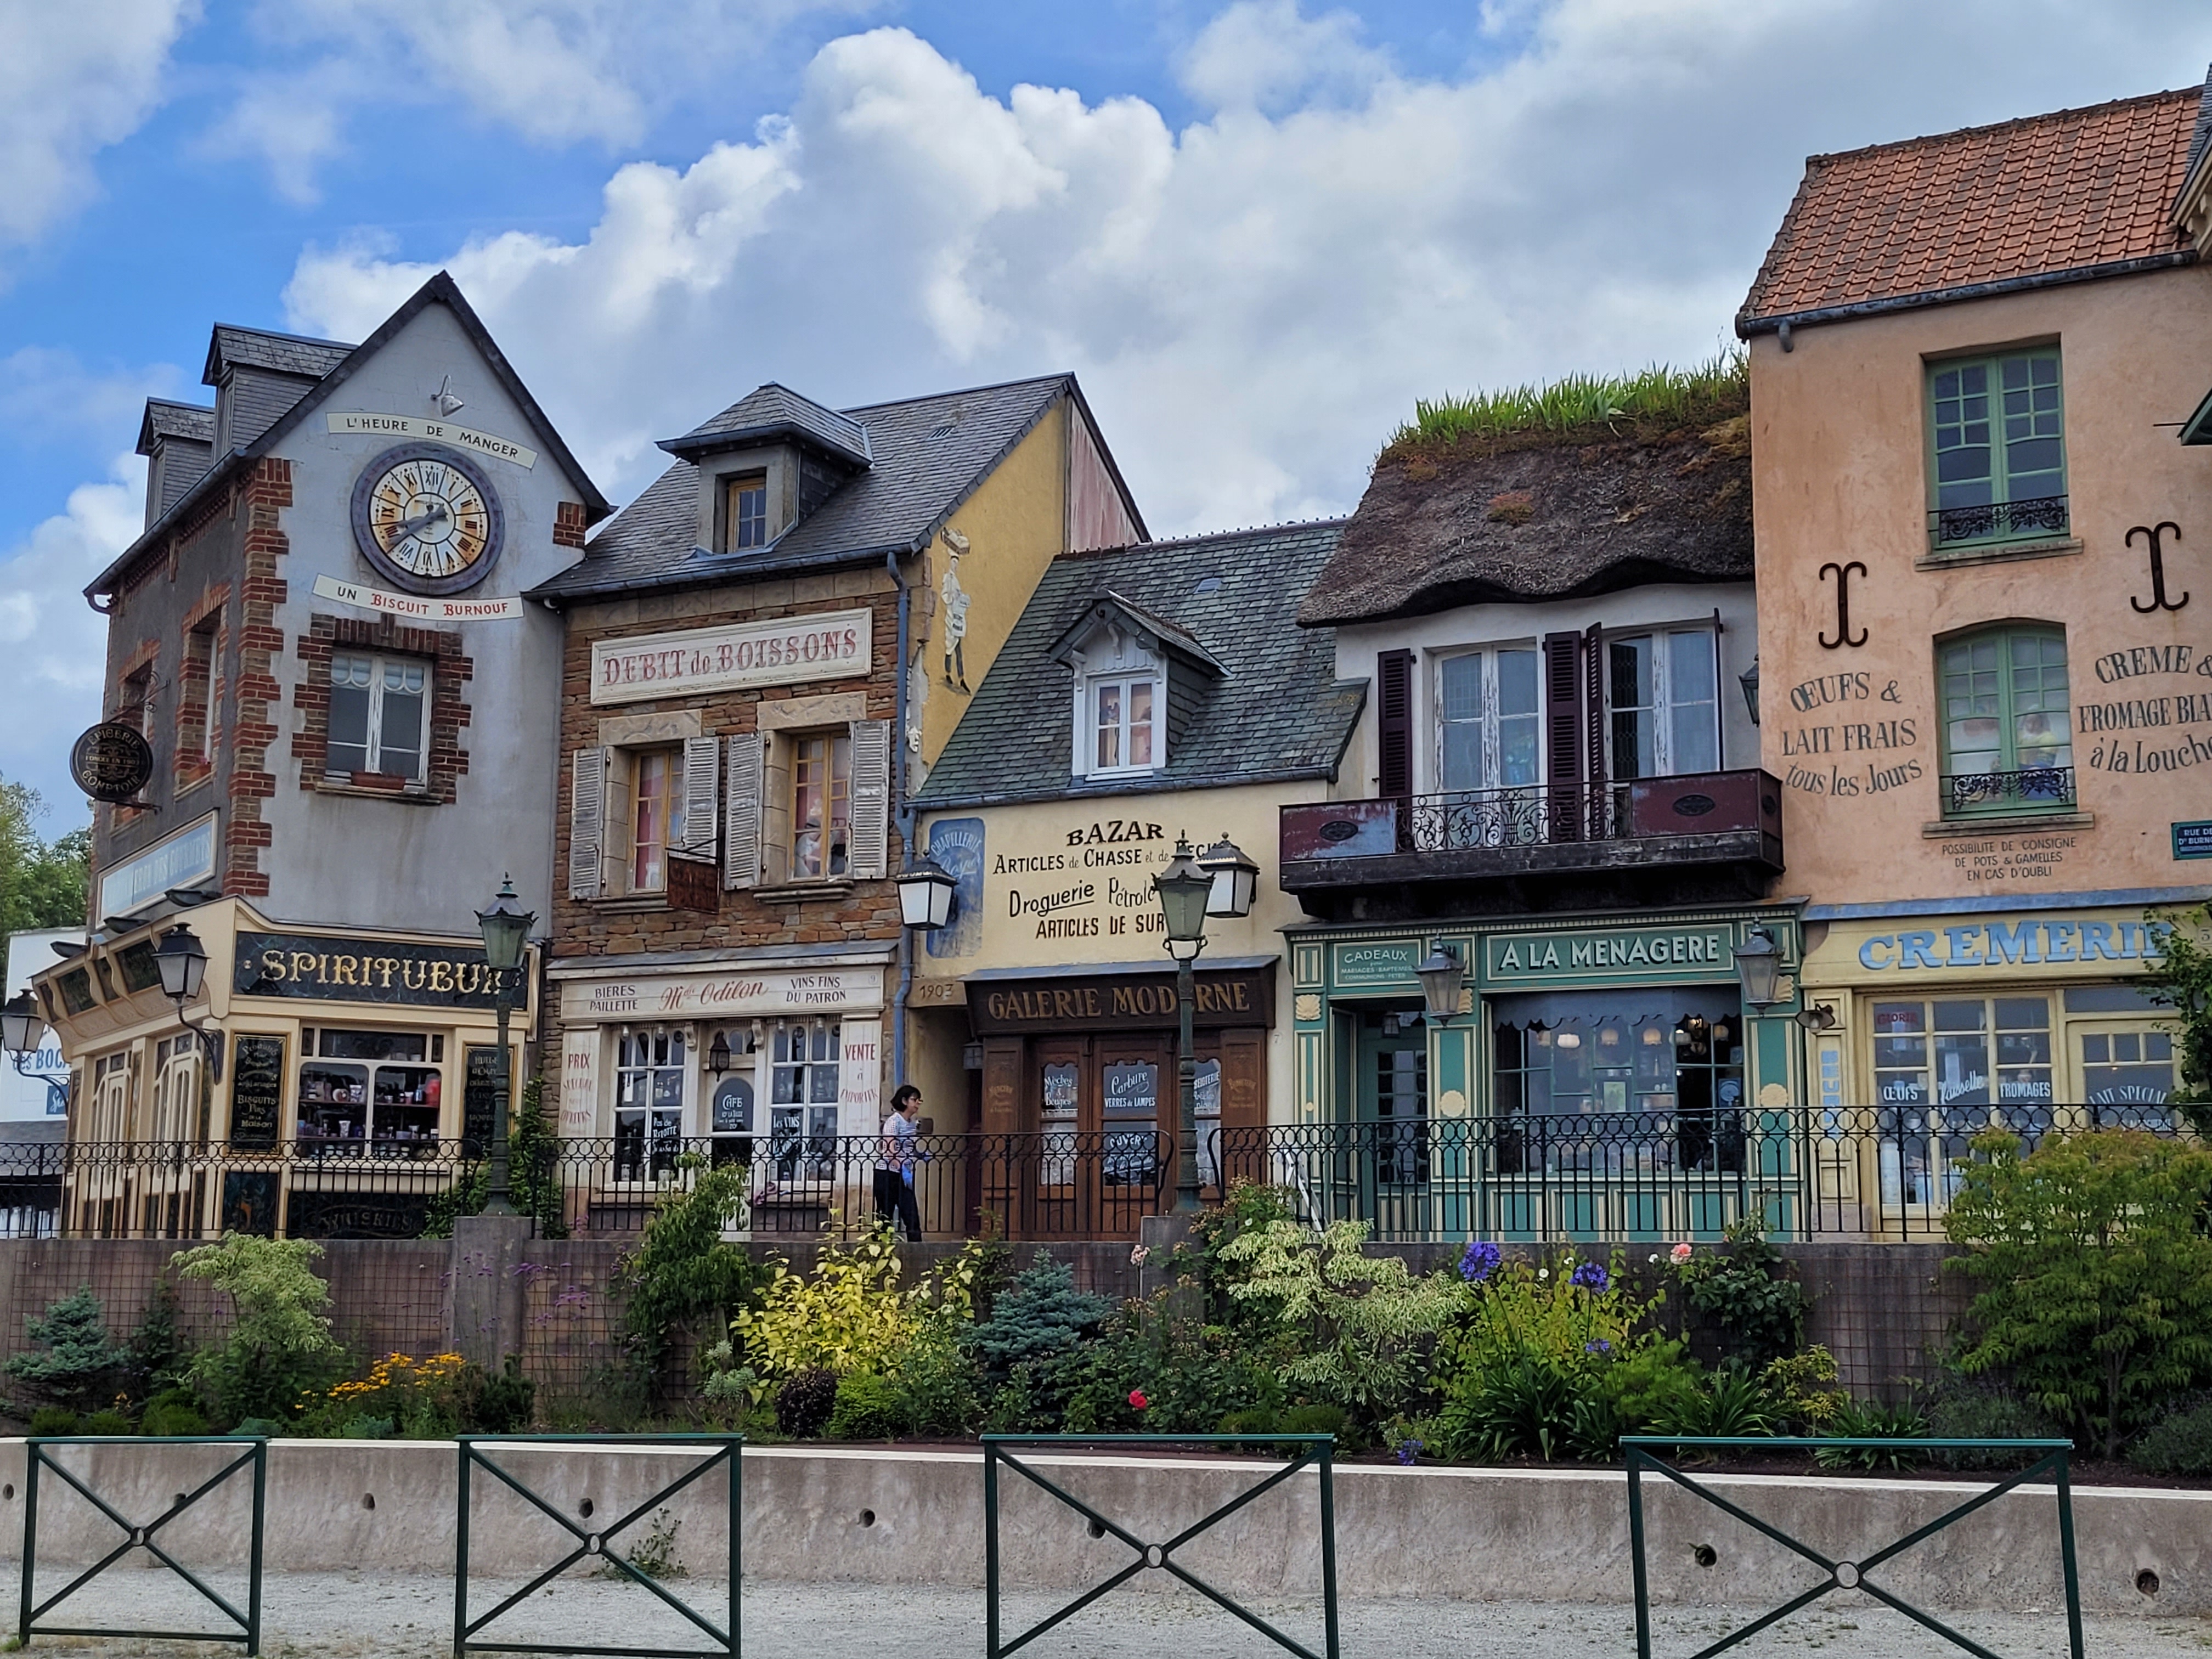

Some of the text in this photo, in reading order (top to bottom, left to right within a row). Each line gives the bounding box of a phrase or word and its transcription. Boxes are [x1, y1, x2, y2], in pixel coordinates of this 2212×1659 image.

[347, 417, 518, 458] L'HEURE DE MANGER
[426, 471, 438, 486] XII
[337, 586, 509, 617] UN BISCUIT BURNOUF
[602, 629, 857, 686] DEBIT de BOISSONS
[2095, 645, 2193, 684] CREME
[1790, 672, 1903, 713] ŒUFS &
[2078, 697, 2171, 733] FROMAGE
[87, 729, 140, 749] EPICERIE
[1782, 718, 1917, 757] LAIT FRAIS
[2090, 737, 2104, 769] à
[2107, 739, 2129, 773] la
[82, 770, 141, 792] COMPTOIR
[1785, 758, 1922, 796] tous les Jours
[930, 831, 983, 856] CHAPELLERIE
[1066, 820, 1165, 847] BAZAR
[2183, 828, 2200, 837] RUE
[1942, 837, 2077, 855] POSSIBILITE DE CONSIGNE
[992, 854, 1064, 874] ARTICLES
[1068, 855, 1080, 869] de
[1084, 848, 1142, 867] CHASSE
[1145, 849, 1154, 864] et
[1158, 849, 1170, 862] de
[1955, 851, 2063, 868] DE POTS & GAMELLES
[1967, 866, 2052, 881] EN CAS D'OUBLI
[1009, 879, 1095, 917] Droguerie
[1036, 917, 1099, 939] ARTICLES
[1136, 913, 1165, 933] SUR
[2200, 928, 2210, 941] 5
[1344, 949, 1408, 963] CADEAUX
[1499, 935, 1720, 970] A LA MENAGERE
[261, 949, 503, 996] SPIRITUEUX
[790, 975, 840, 990] VINS FINS
[595, 985, 635, 999] BIERES
[700, 979, 769, 1005] Odilon
[786, 990, 847, 1005] DU PATRON
[988, 982, 1251, 1020] GALERIE MODRNE
[589, 999, 638, 1012] PAILLETTE
[36, 1048, 72, 1069] BOC
[568, 1053, 591, 1069] PRIX
[845, 1043, 877, 1061] VENTE
[1111, 1071, 1149, 1096] Carbure
[1883, 1085, 1918, 1102] ŒUFS
[2000, 1081, 2051, 1098] FROMAGES
[237, 1094, 276, 1105] BISCUITS
[1104, 1097, 1127, 1108] VERRES
[1133, 1097, 1156, 1108] LAMPES
